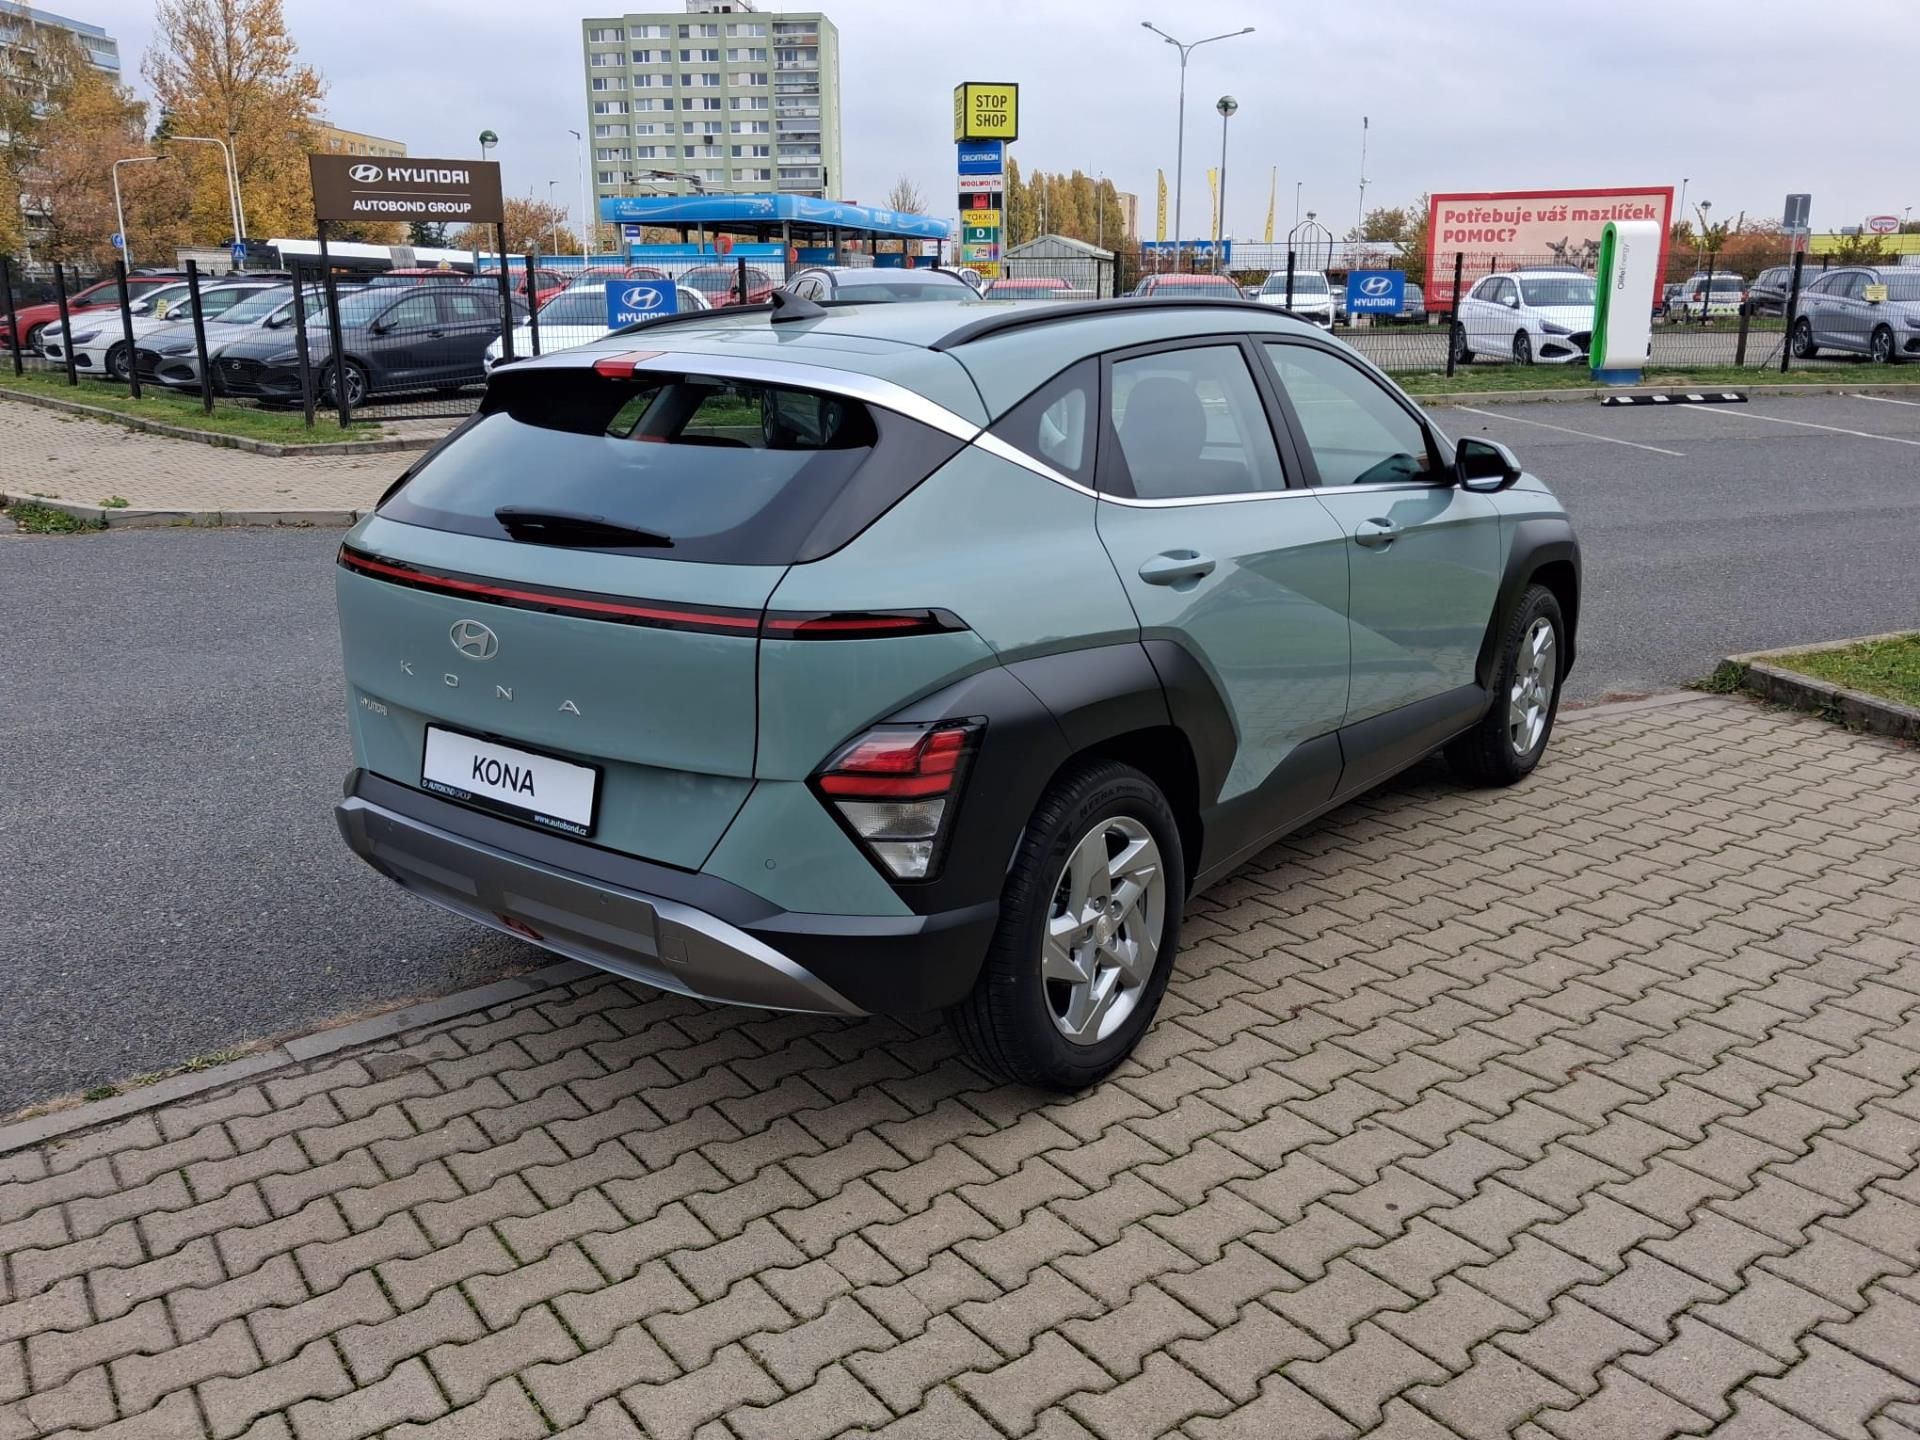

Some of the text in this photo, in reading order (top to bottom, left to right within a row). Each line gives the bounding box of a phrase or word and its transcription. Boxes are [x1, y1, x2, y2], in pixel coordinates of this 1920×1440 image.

[976, 95, 1007, 108] STOP
[976, 114, 1007, 127] SHOP
[388, 168, 469, 184] HYUNDAI
[353, 200, 471, 214] AUTOBOND GROUP
[1444, 204, 1656, 225] Potřebuje váš mazlíček
[976, 229, 985, 238] D
[1443, 229, 1516, 243] POMOC?
[1354, 298, 1396, 307] HYUNDAI
[617, 312, 670, 322] HYUND
[400, 660, 581, 716] KONA
[471, 755, 535, 797] KONA
[534, 814, 588, 836] www.autobond.cz
